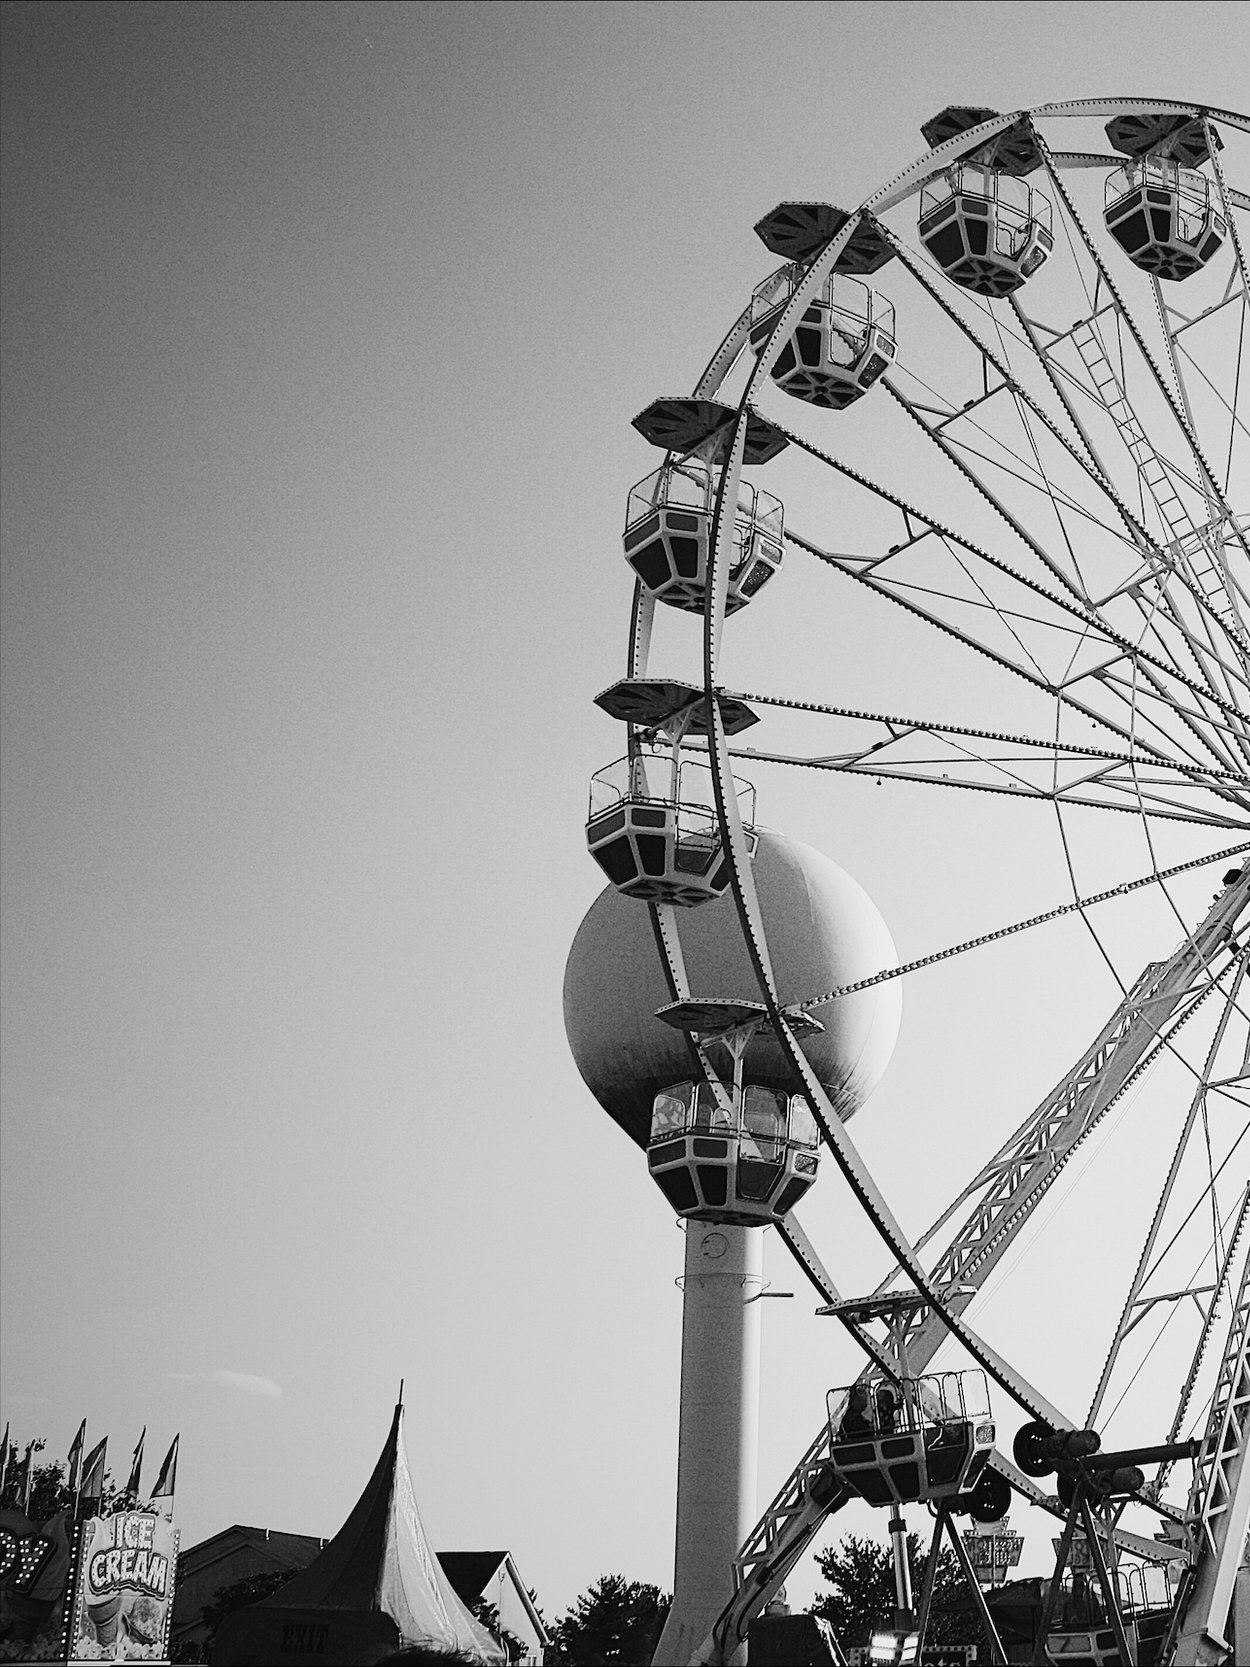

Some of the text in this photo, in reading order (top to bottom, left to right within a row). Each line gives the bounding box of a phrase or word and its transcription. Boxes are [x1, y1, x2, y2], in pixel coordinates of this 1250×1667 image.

[115, 1515, 156, 1550] ICE
[91, 1548, 169, 1596] CREAM
[280, 1623, 331, 1654] EXIT
